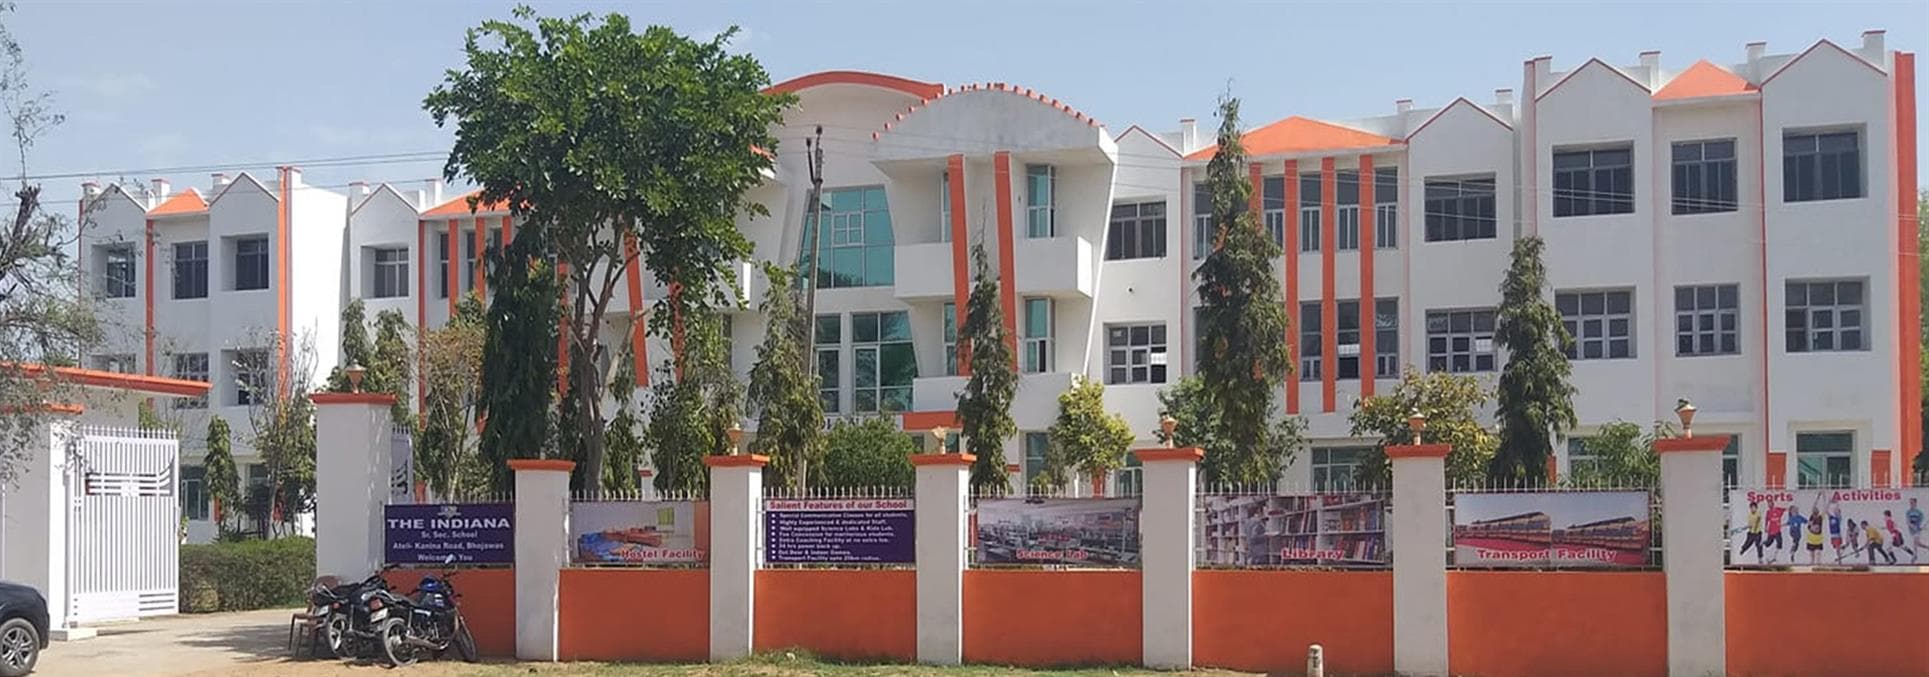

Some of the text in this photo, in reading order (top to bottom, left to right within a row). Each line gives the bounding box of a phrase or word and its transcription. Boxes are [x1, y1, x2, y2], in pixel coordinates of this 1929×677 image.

[1747, 490, 1901, 502] Sports Activities
[770, 501, 907, 510] Salient Features of our School
[388, 518, 510, 528] THE INDIANA
[452, 530, 478, 538] School
[622, 550, 705, 560] Hostel Facility
[1016, 550, 1063, 559] Science
[1282, 548, 1344, 560] Library
[1477, 549, 1616, 561] Transport Facility
